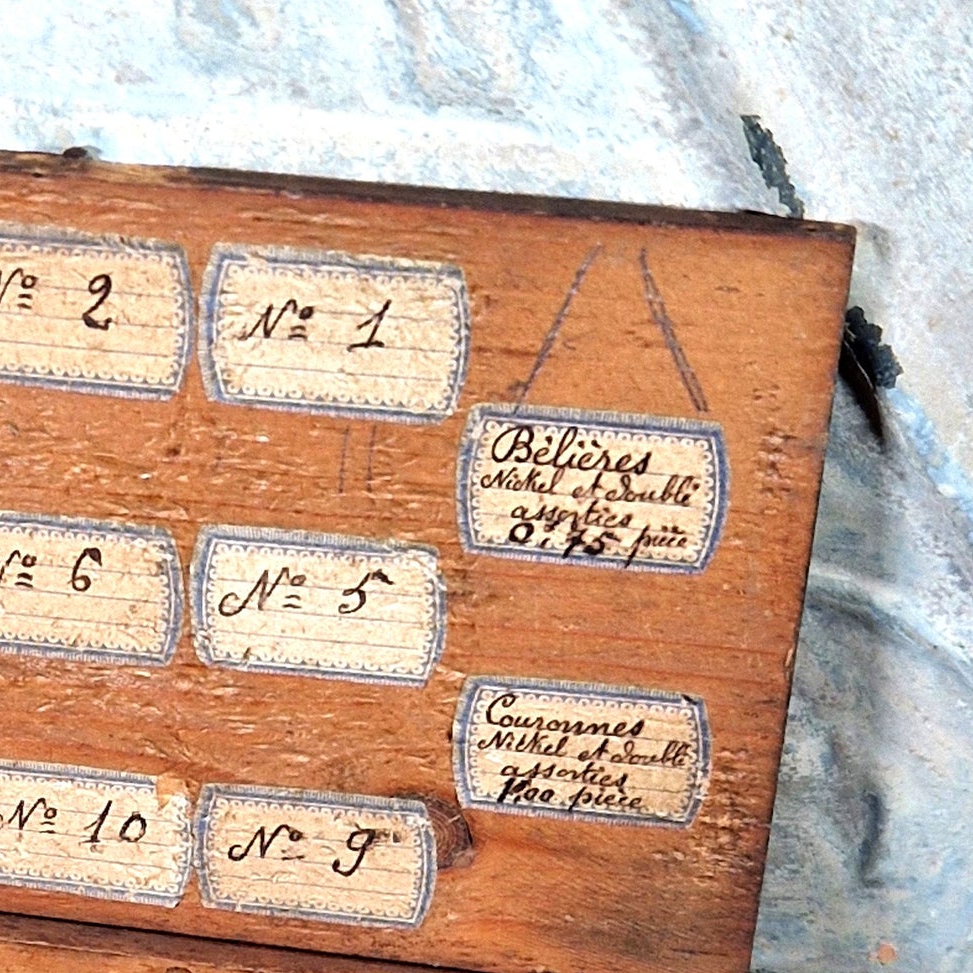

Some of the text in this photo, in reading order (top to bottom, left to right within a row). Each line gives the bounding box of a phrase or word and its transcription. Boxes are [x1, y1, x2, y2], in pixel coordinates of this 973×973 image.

[81, 273, 113, 331] 2
[347, 299, 393, 352] 1
[571, 472, 604, 501] et
[510, 499, 634, 530] assorties
[70, 547, 103, 593] 6
[338, 568, 396, 614] 5
[485, 694, 645, 738] Couronnes
[577, 738, 609, 763] et
[500, 761, 629, 788] assorties
[83, 800, 148, 845] 10
[332, 827, 376, 878] 9
